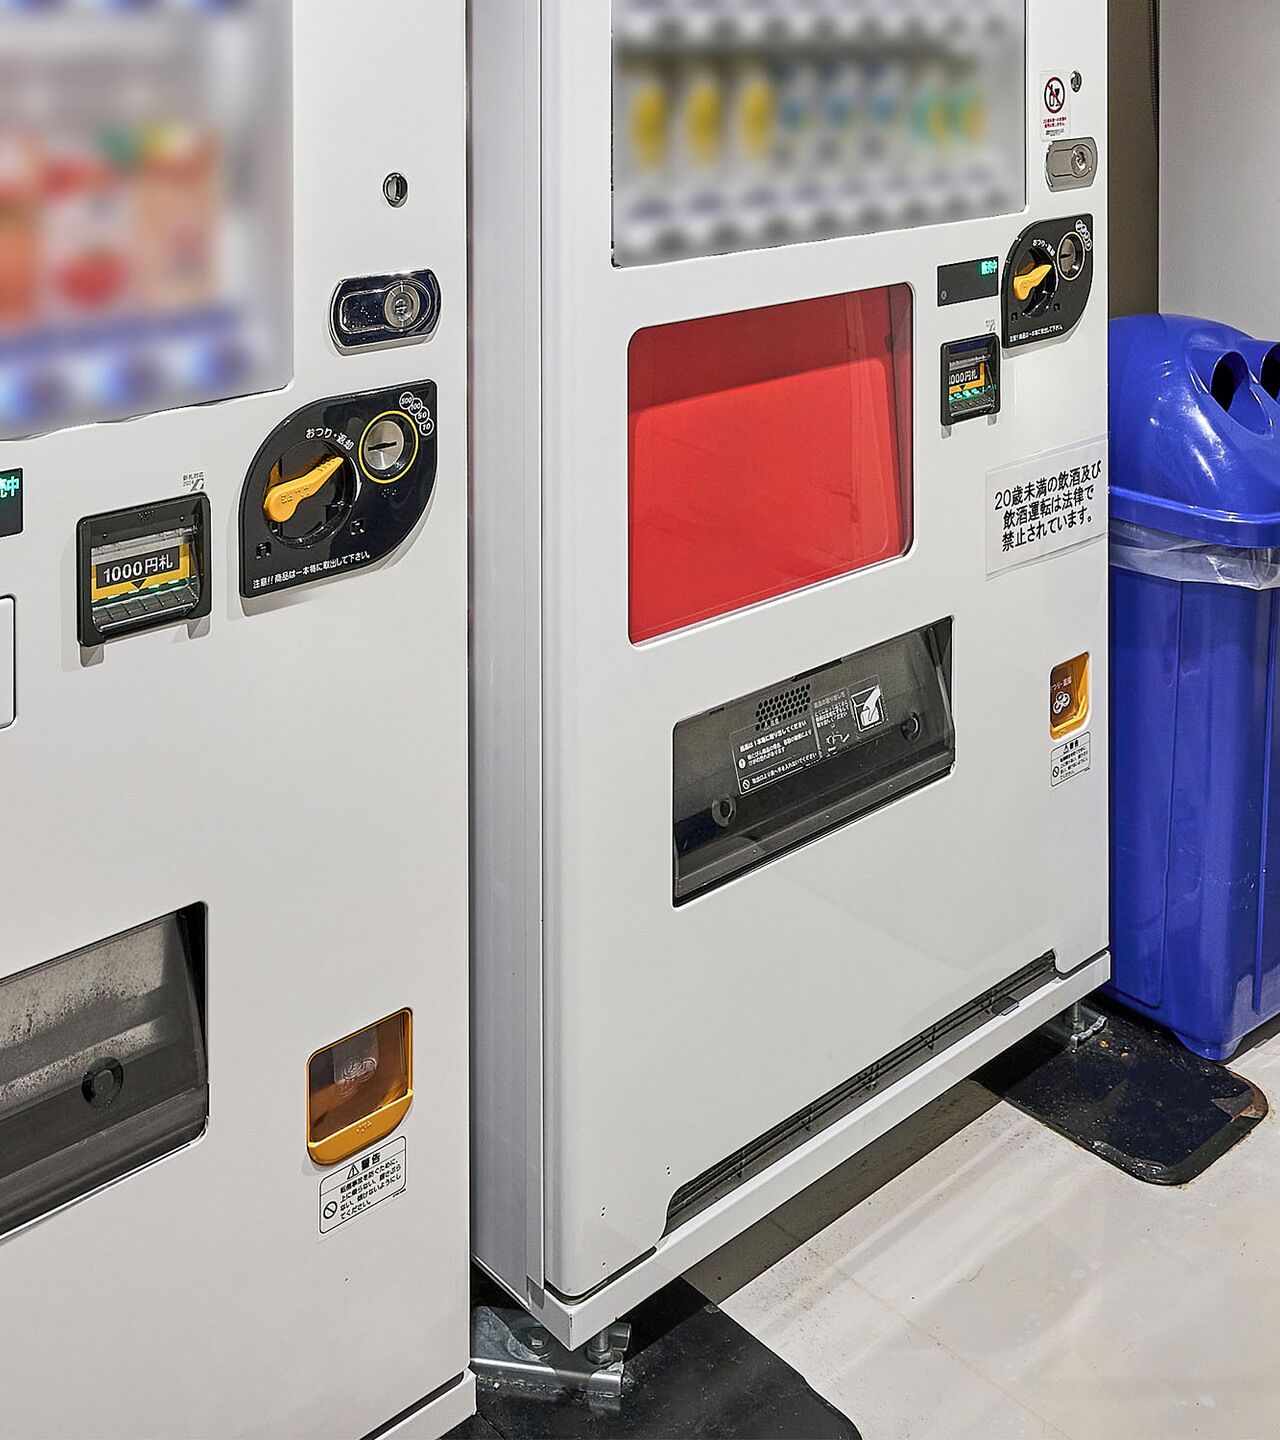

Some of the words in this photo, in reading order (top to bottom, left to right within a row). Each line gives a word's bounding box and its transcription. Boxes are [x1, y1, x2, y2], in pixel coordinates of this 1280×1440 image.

[305, 427, 355, 451] おつり・返却
[422, 422, 431, 431] 10
[994, 459, 1102, 511] 20歳未満の飲酒及び
[1002, 484, 1095, 531] 飲酒運転は法律で
[1001, 505, 1092, 552] 禁止されています。
[103, 553, 174, 583] 1000円札
